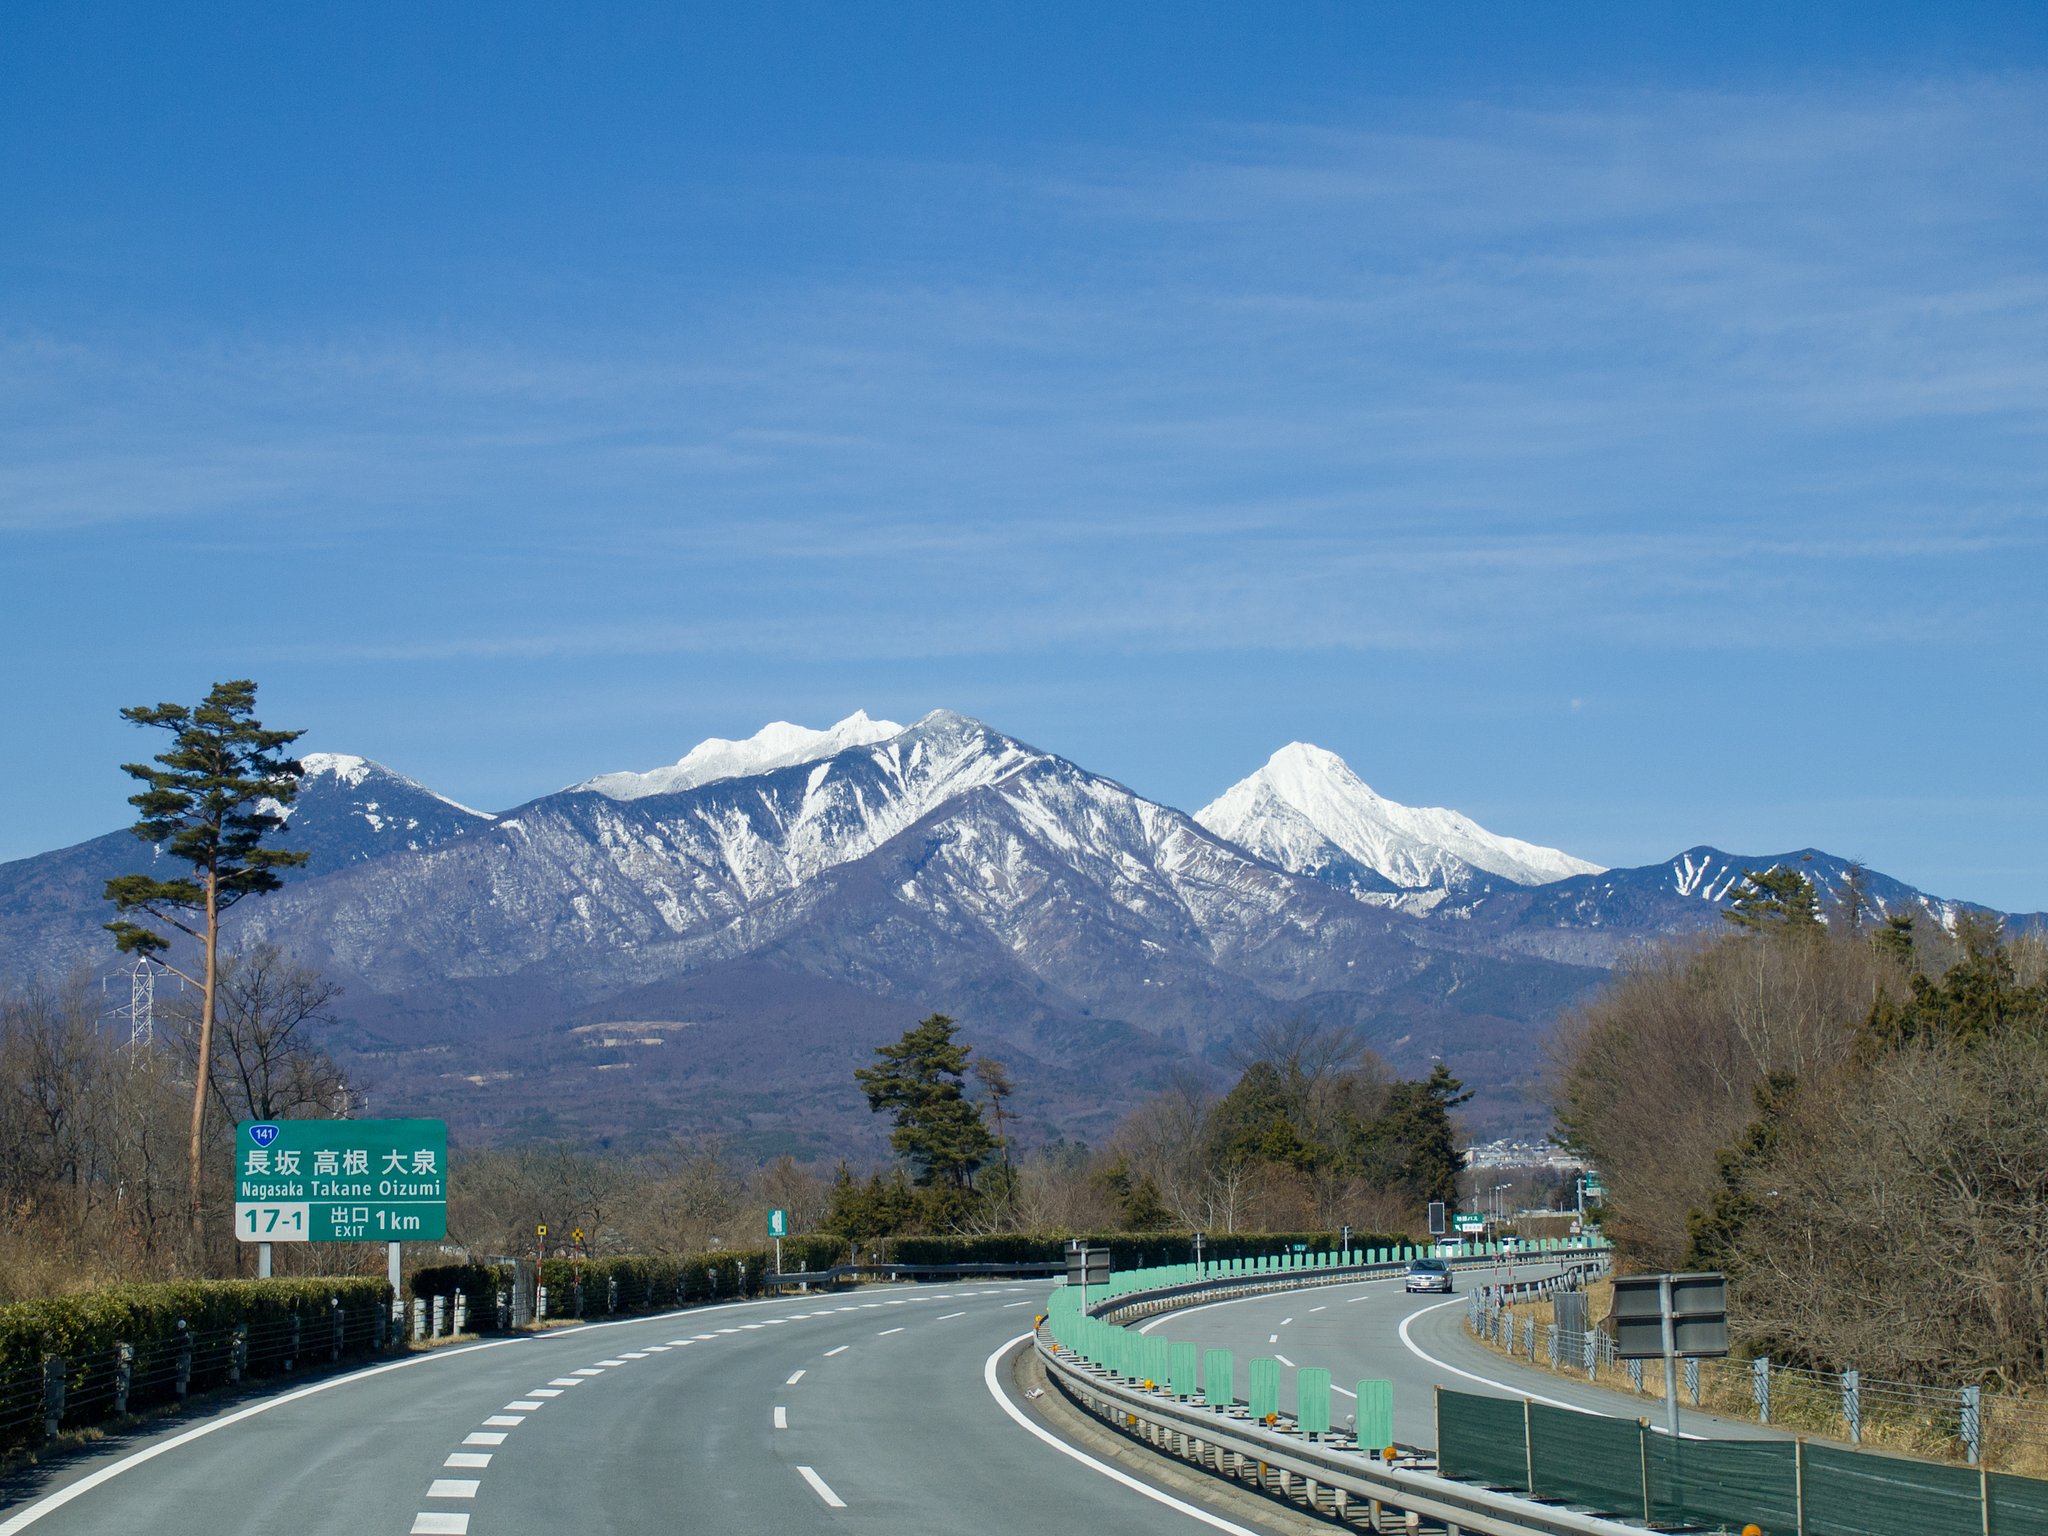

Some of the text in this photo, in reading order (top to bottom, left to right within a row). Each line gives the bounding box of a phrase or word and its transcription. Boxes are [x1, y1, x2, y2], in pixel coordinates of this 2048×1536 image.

[256, 1129, 273, 1139] 141
[244, 1149, 438, 1176] 長坂 高根 大泉
[242, 1180, 440, 1200] Nagasaka Takane Oizumi
[244, 1209, 302, 1233] 17-1
[330, 1206, 369, 1224] 出口
[335, 1225, 365, 1237] EXIT
